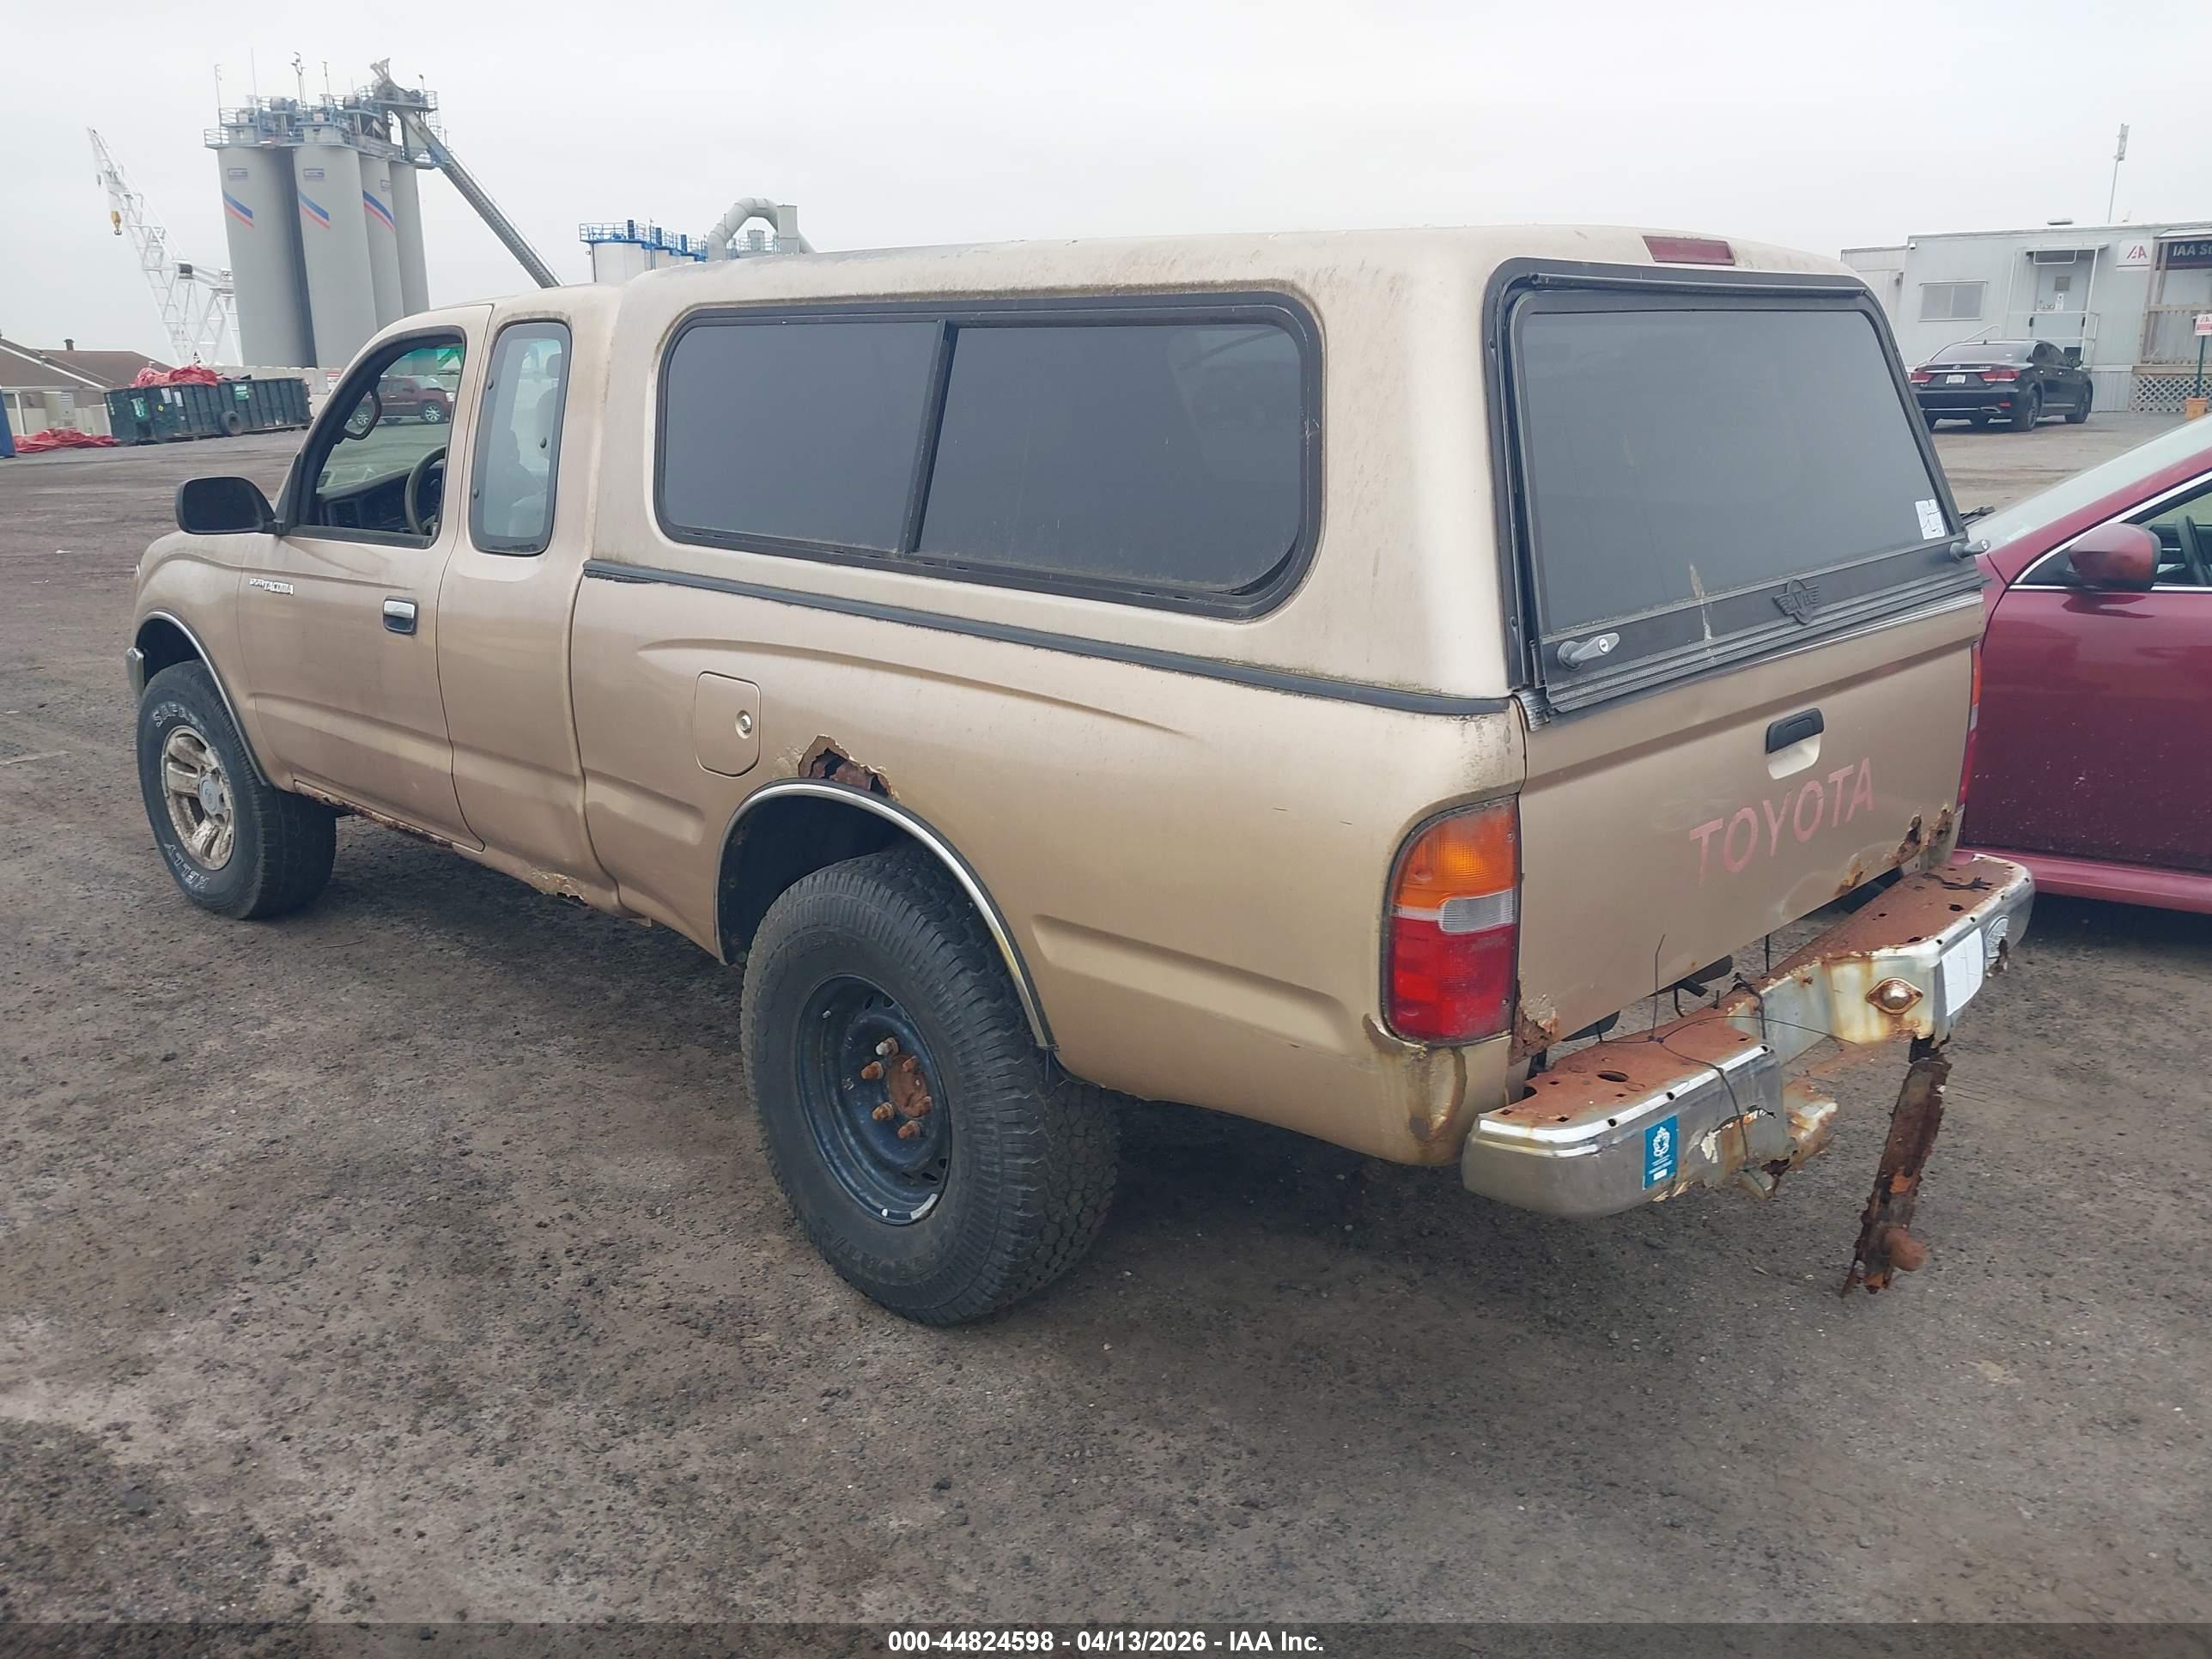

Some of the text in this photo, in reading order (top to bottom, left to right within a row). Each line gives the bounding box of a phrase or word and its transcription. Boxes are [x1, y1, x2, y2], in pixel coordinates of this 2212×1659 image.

[2172, 245, 2196, 257] IAA
[1689, 757, 1874, 887] TOYOTA
[164, 843, 210, 889] KELLY
